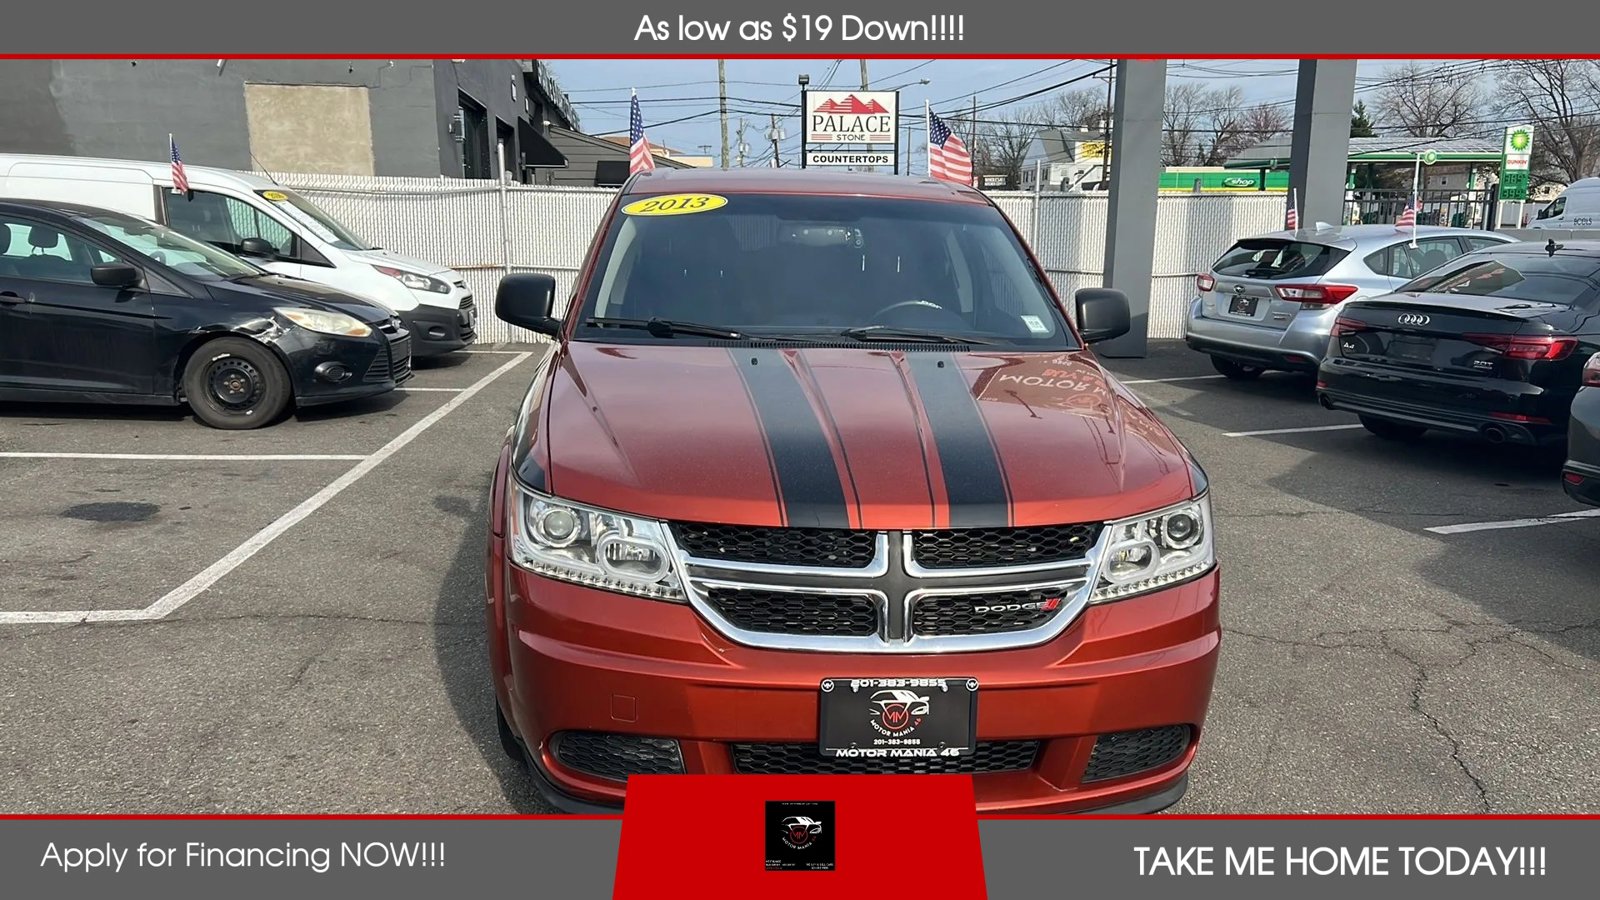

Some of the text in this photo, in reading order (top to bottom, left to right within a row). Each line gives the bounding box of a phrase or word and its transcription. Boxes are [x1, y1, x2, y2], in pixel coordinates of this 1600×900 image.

[812, 115, 891, 133] PALACE
[812, 155, 889, 164] COUNTERTOPS
[639, 196, 710, 213] 2013
[974, 601, 1048, 613] DODGE
[870, 719, 892, 737] MOTOR
[892, 726, 915, 737] MANIA
[835, 749, 960, 758] MOTOR MANIA 46
